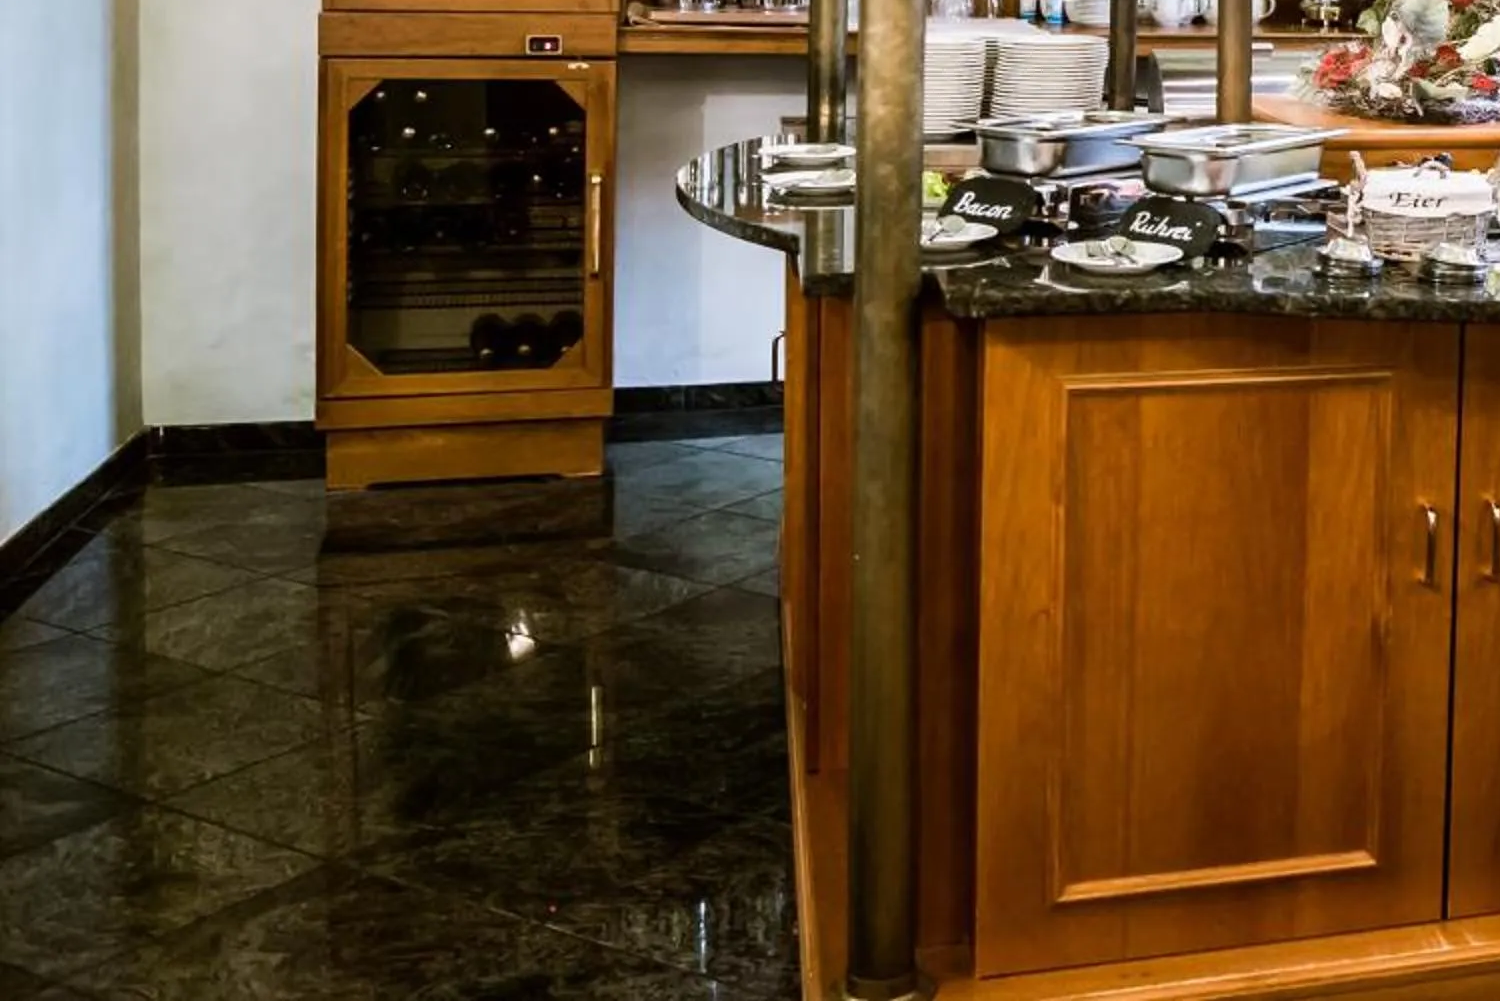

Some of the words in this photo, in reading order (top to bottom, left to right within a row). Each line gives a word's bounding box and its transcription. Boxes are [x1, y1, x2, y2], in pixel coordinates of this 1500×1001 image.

[953, 191, 1013, 220] Bacon
[1389, 192, 1449, 208] Eier
[1129, 211, 1202, 242] Rührei
